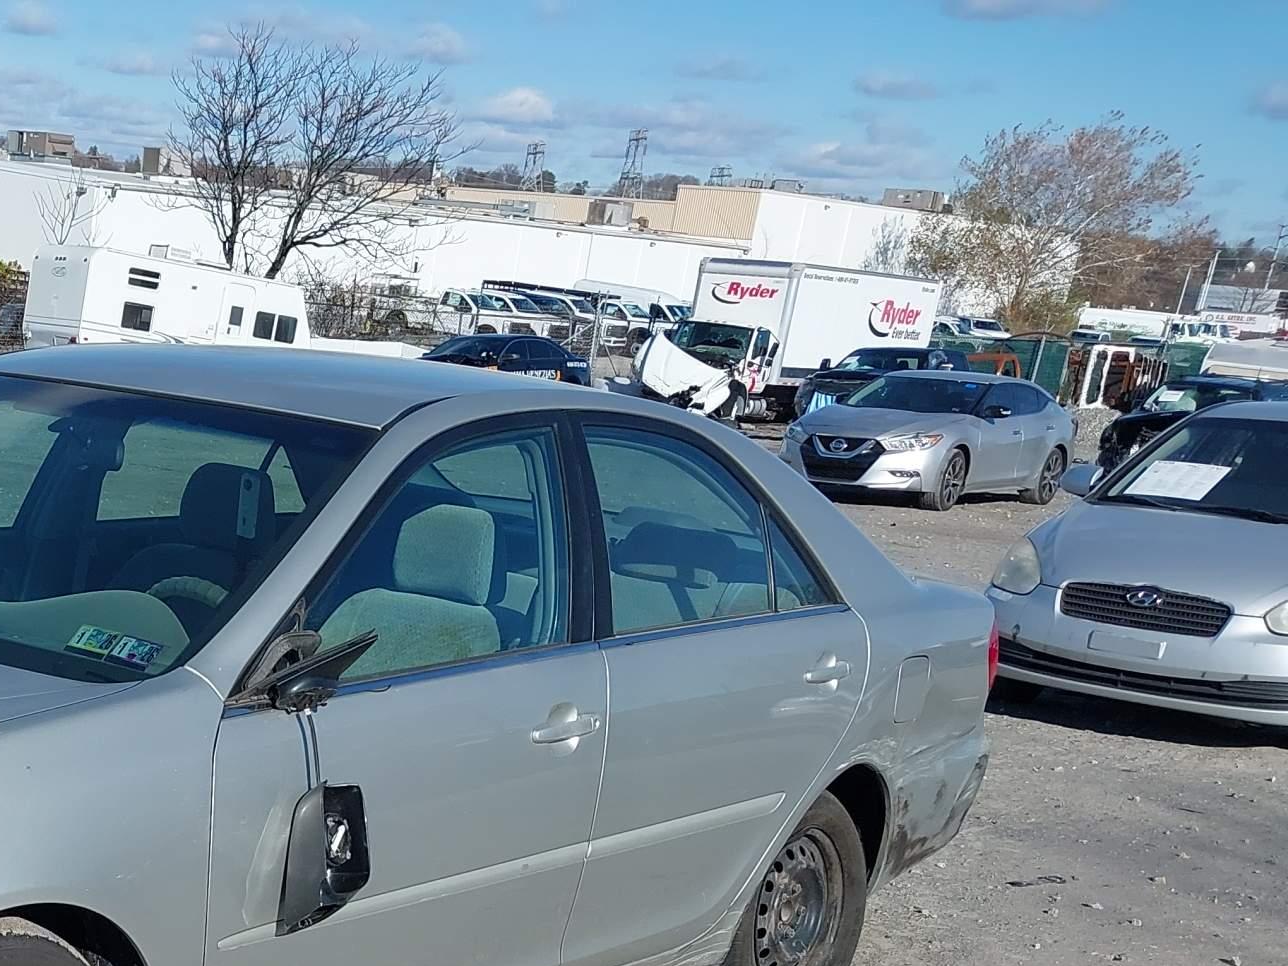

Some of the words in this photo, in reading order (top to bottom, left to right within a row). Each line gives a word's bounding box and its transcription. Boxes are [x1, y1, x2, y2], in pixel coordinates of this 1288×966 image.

[726, 281, 779, 299] Ryder
[880, 299, 921, 329] Ryder
[892, 327, 904, 339] Ever
